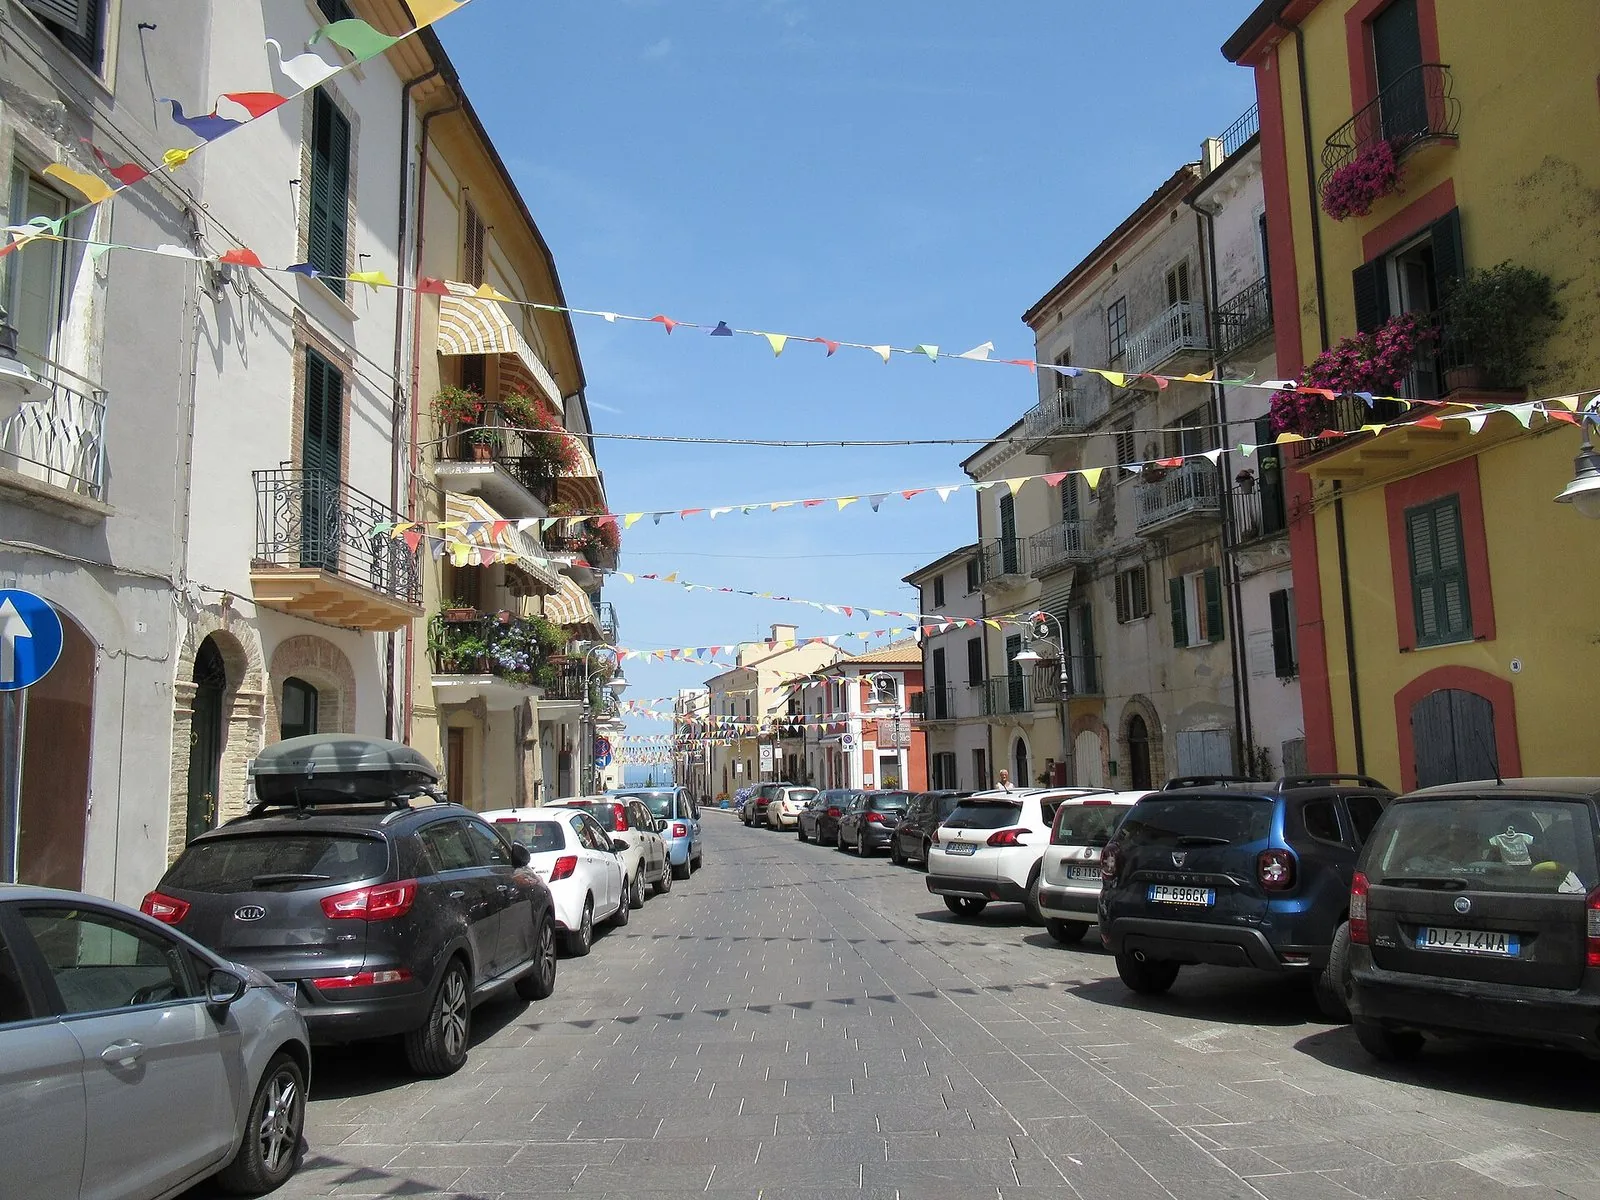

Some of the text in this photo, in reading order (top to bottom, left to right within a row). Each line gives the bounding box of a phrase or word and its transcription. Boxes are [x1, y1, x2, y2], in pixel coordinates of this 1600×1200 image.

[1072, 867, 1081, 877] FB
[1145, 872, 1213, 882] DUSTER
[1155, 886, 1206, 903] FP 696GK
[239, 906, 261, 918] KIA
[1428, 929, 1507, 952] DJ 214WA
